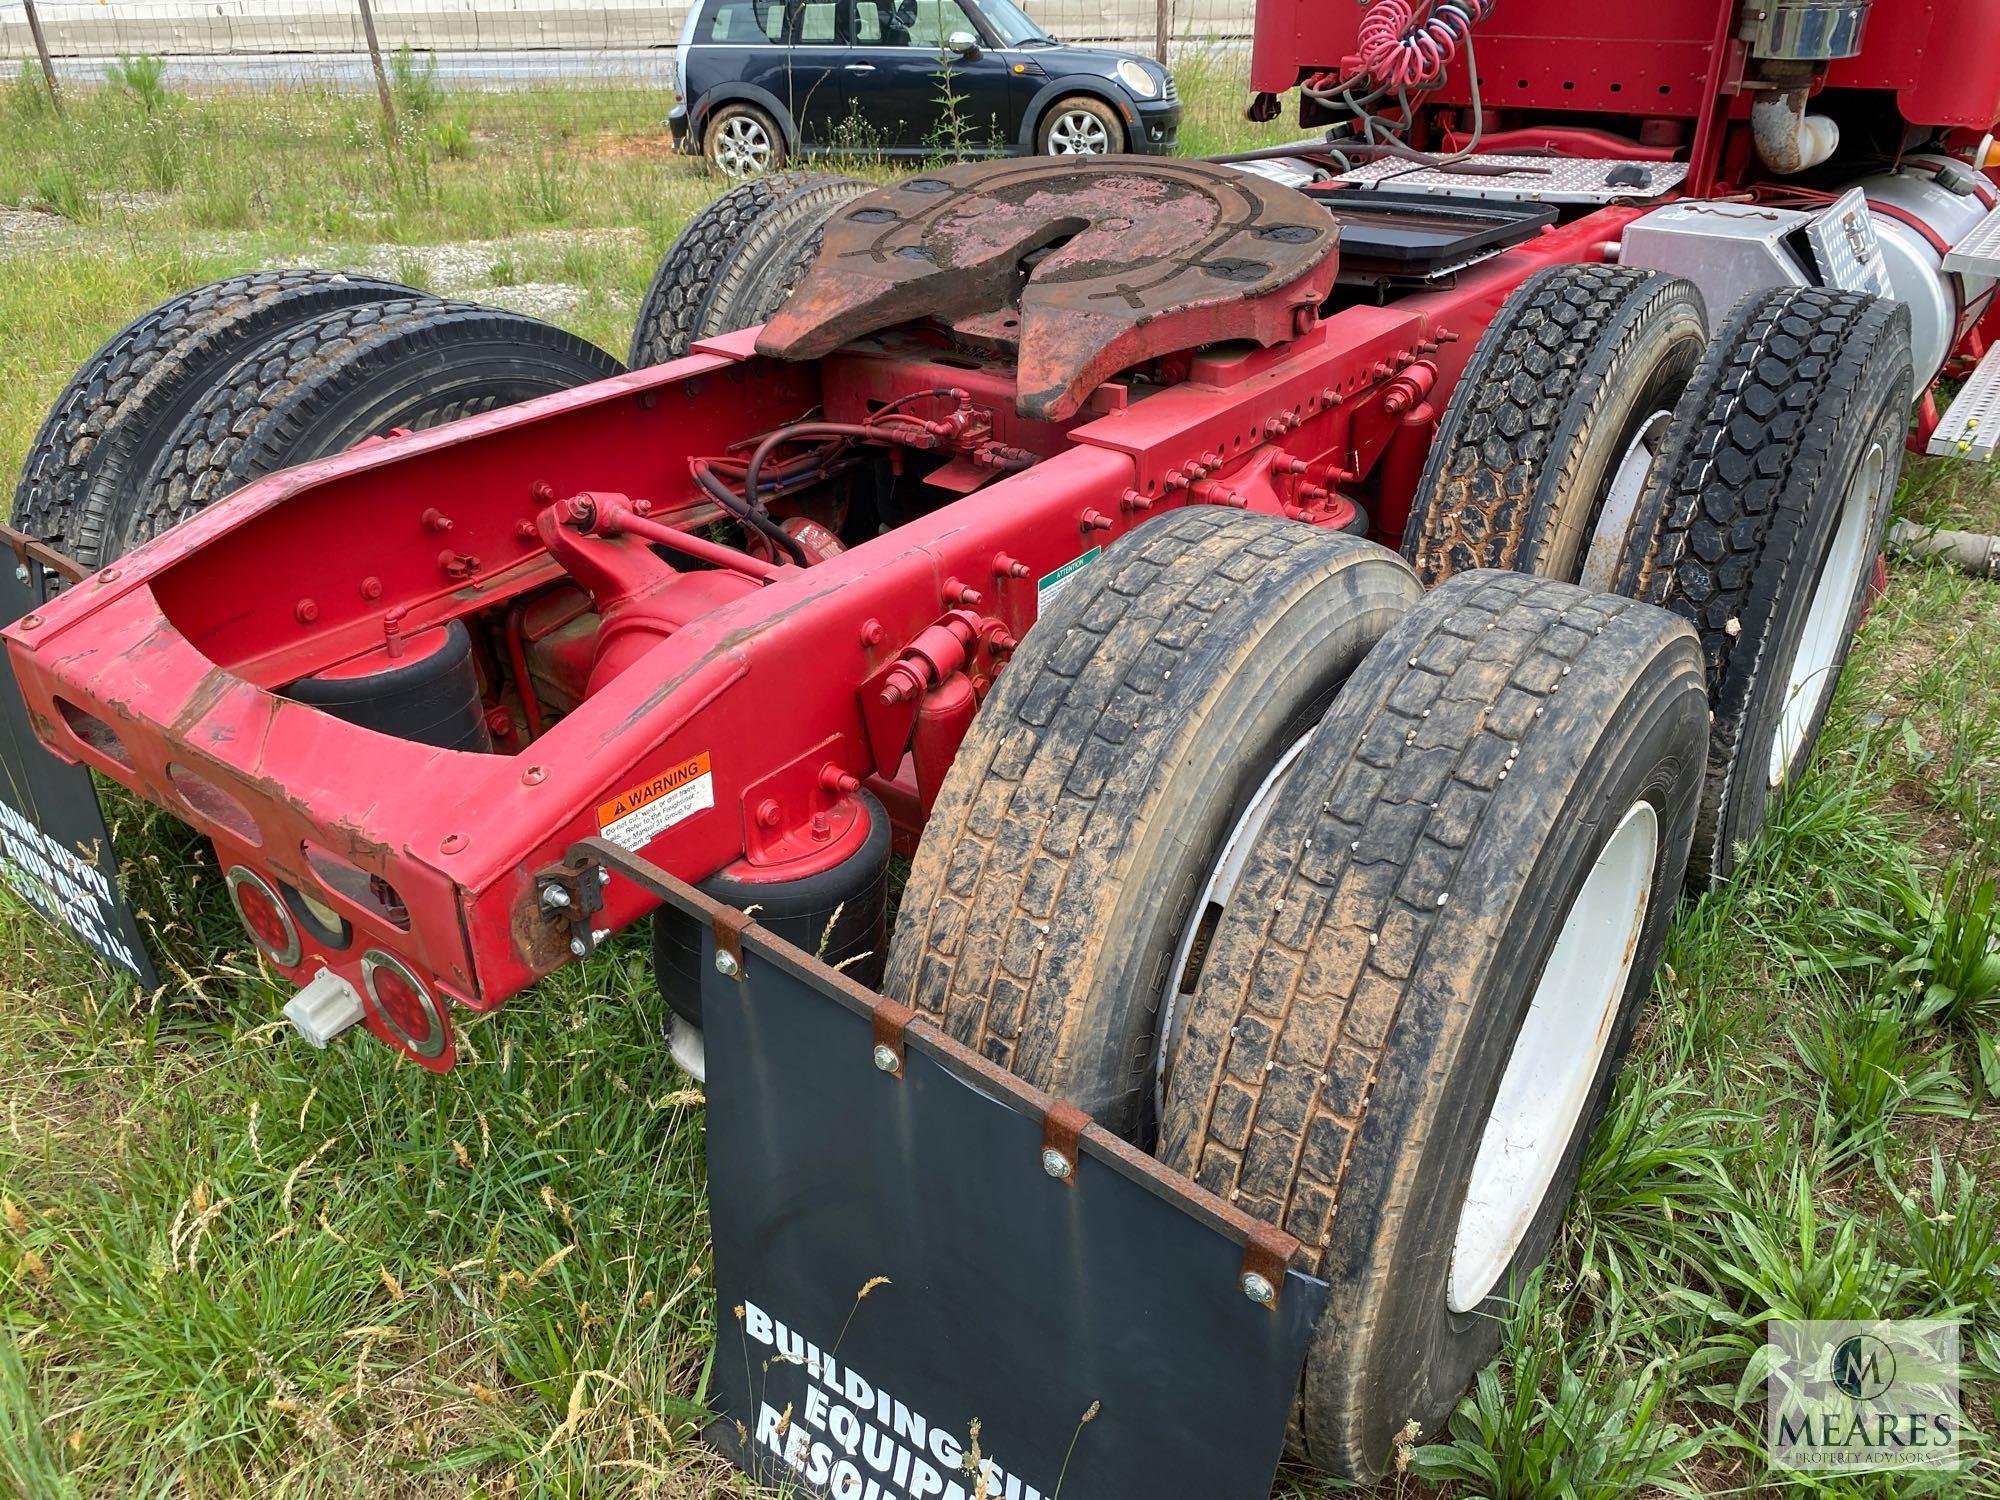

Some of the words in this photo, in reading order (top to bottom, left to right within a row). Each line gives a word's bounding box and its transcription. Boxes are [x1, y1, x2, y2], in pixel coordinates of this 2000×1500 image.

[1056, 558, 1084, 579] ATTENTION
[629, 762, 698, 807] WARNING
[606, 828, 616, 836] Do
[616, 820, 627, 830] not
[625, 822, 641, 834] Refer
[643, 816, 650, 824] to
[650, 810, 662, 820] the
[632, 823, 654, 839] Manual
[664, 809, 682, 822] Group
[44, 833, 114, 906] SUPPLY
[745, 1300, 962, 1469] BUILDING
